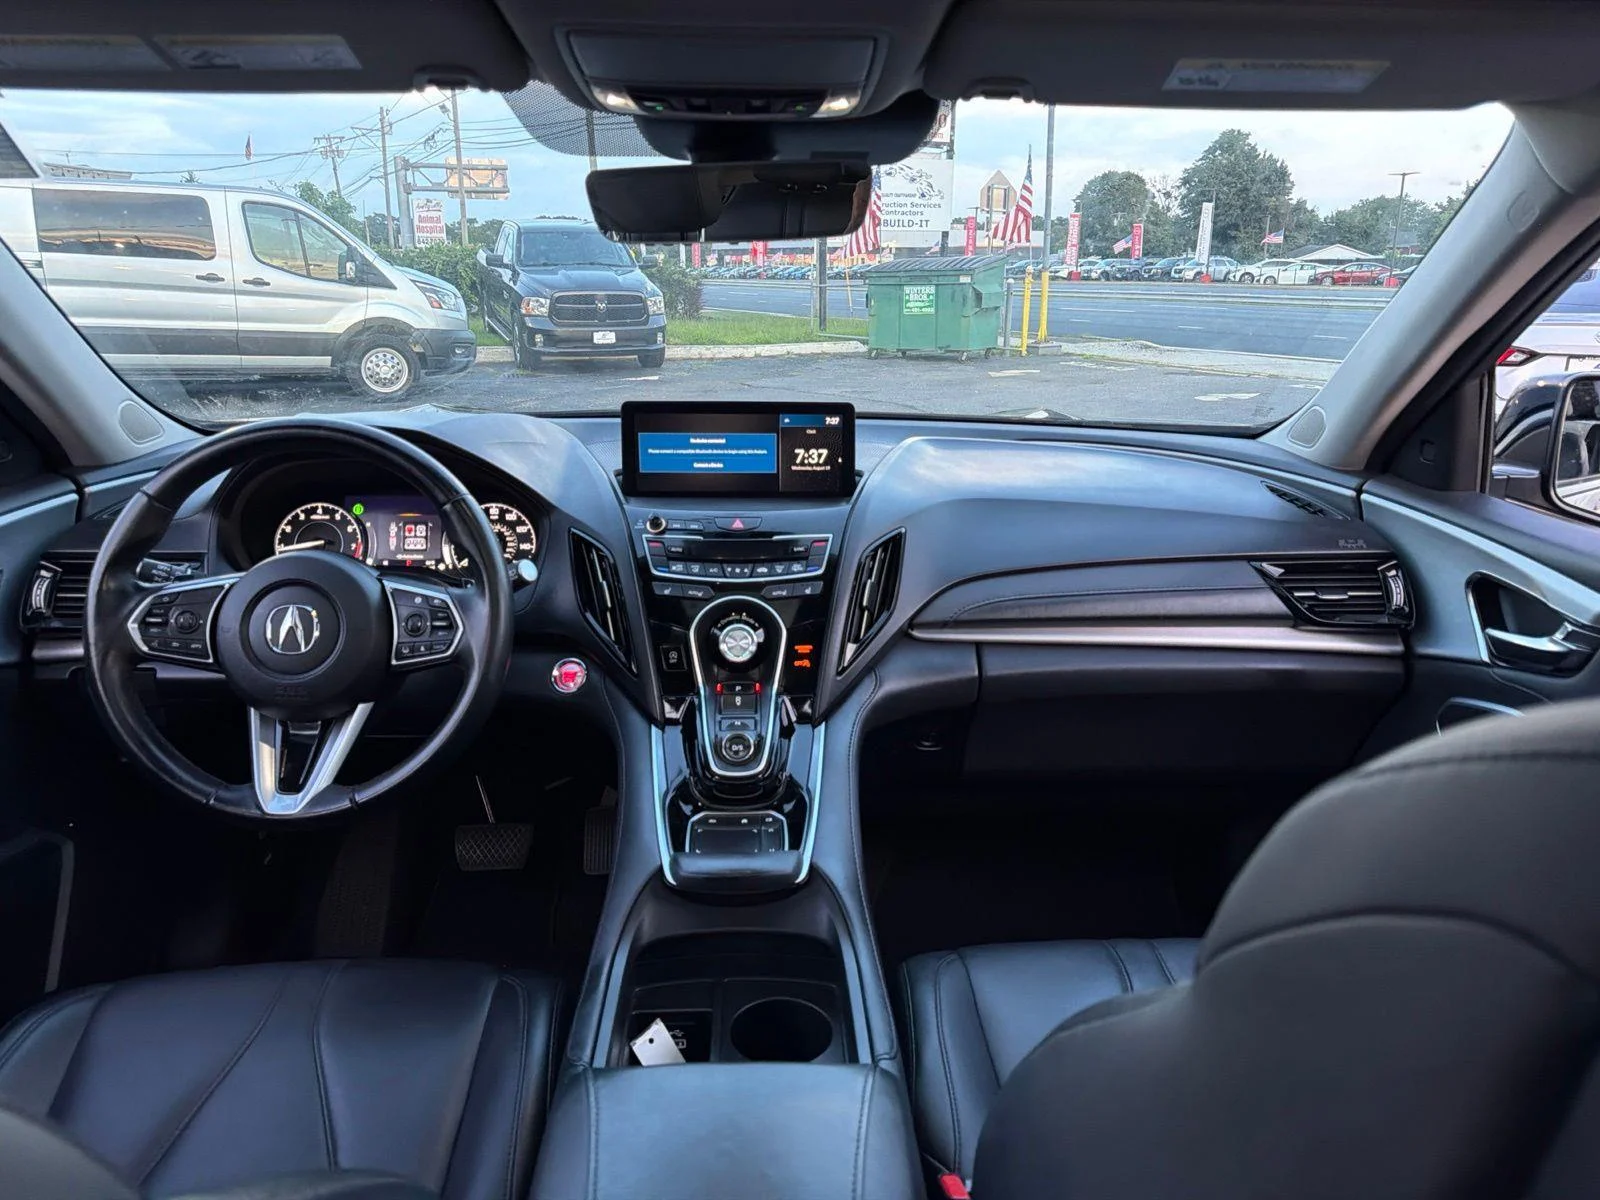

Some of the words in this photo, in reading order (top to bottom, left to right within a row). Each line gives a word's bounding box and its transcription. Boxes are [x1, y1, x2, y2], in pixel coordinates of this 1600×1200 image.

[910, 201, 942, 209] Services
[880, 209, 924, 217] Contractors
[418, 214, 442, 224] Animal
[416, 224, 444, 234] Hospital
[905, 286, 935, 294] WINTERS
[825, 417, 840, 425] 7:37
[794, 448, 828, 465] 7:37
